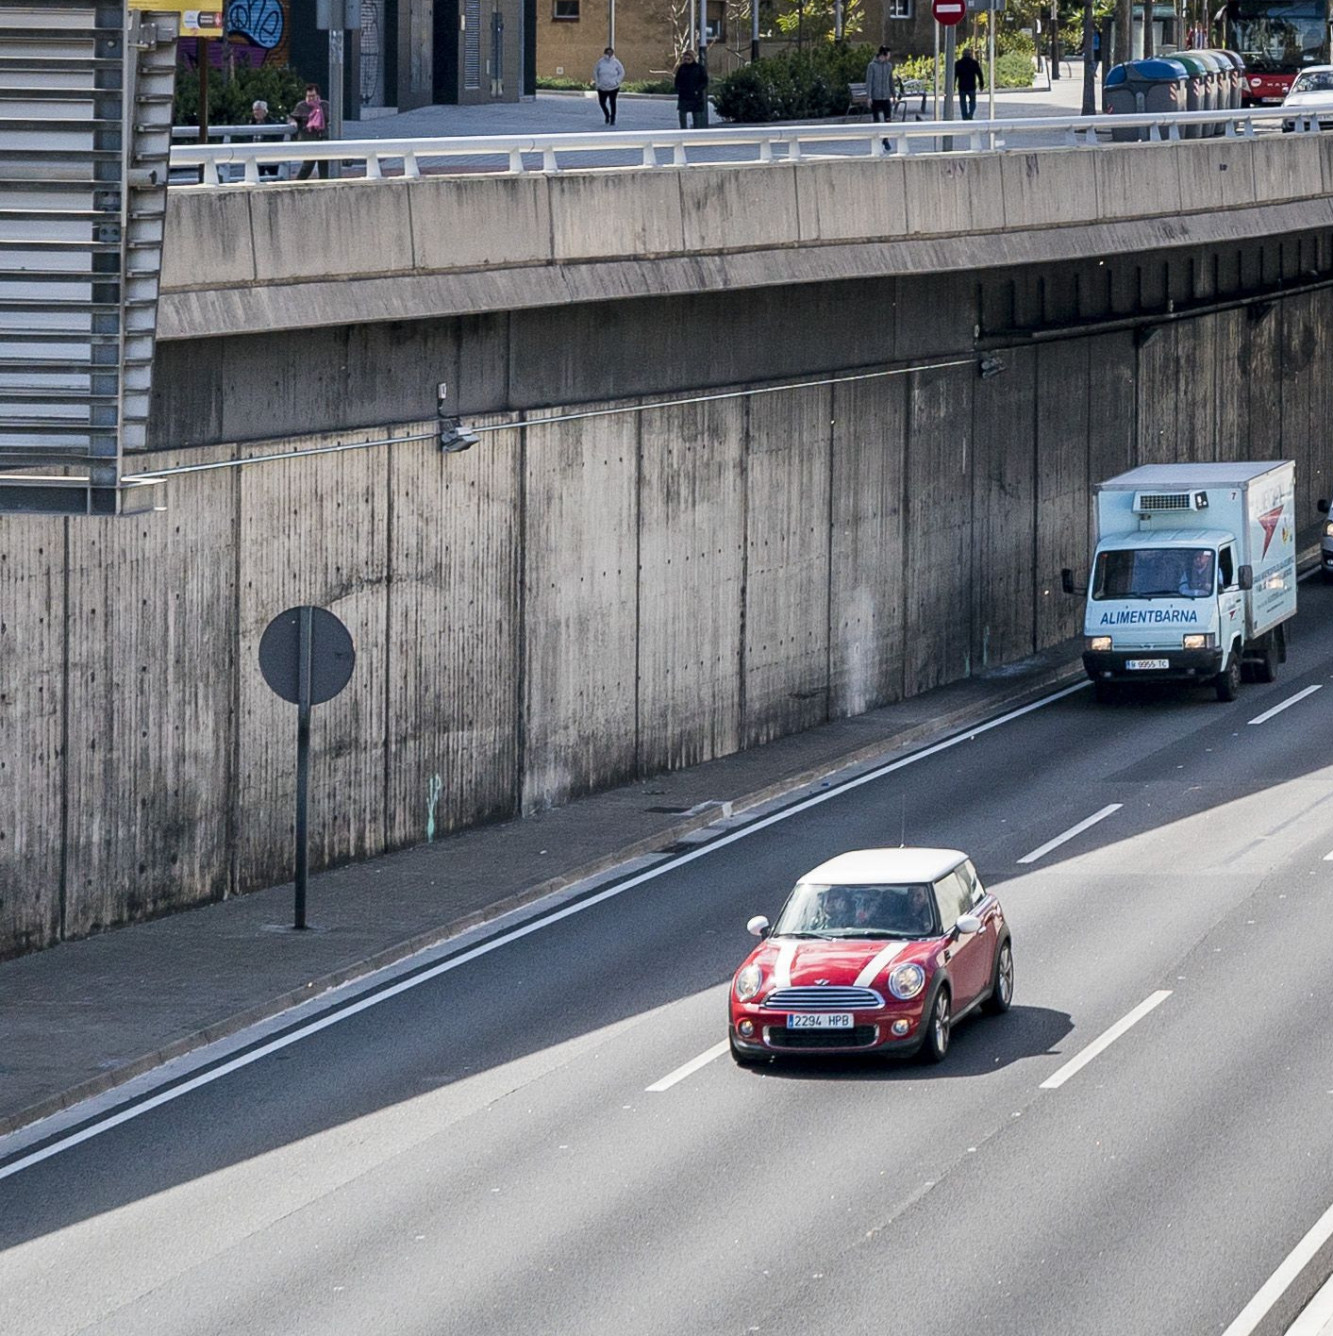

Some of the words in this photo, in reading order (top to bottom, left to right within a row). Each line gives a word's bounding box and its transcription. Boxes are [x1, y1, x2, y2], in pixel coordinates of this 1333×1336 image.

[1100, 610, 1197, 625] ALIMENTBARNA
[795, 1015, 822, 1026] 2294
[828, 1015, 849, 1026] HPB
